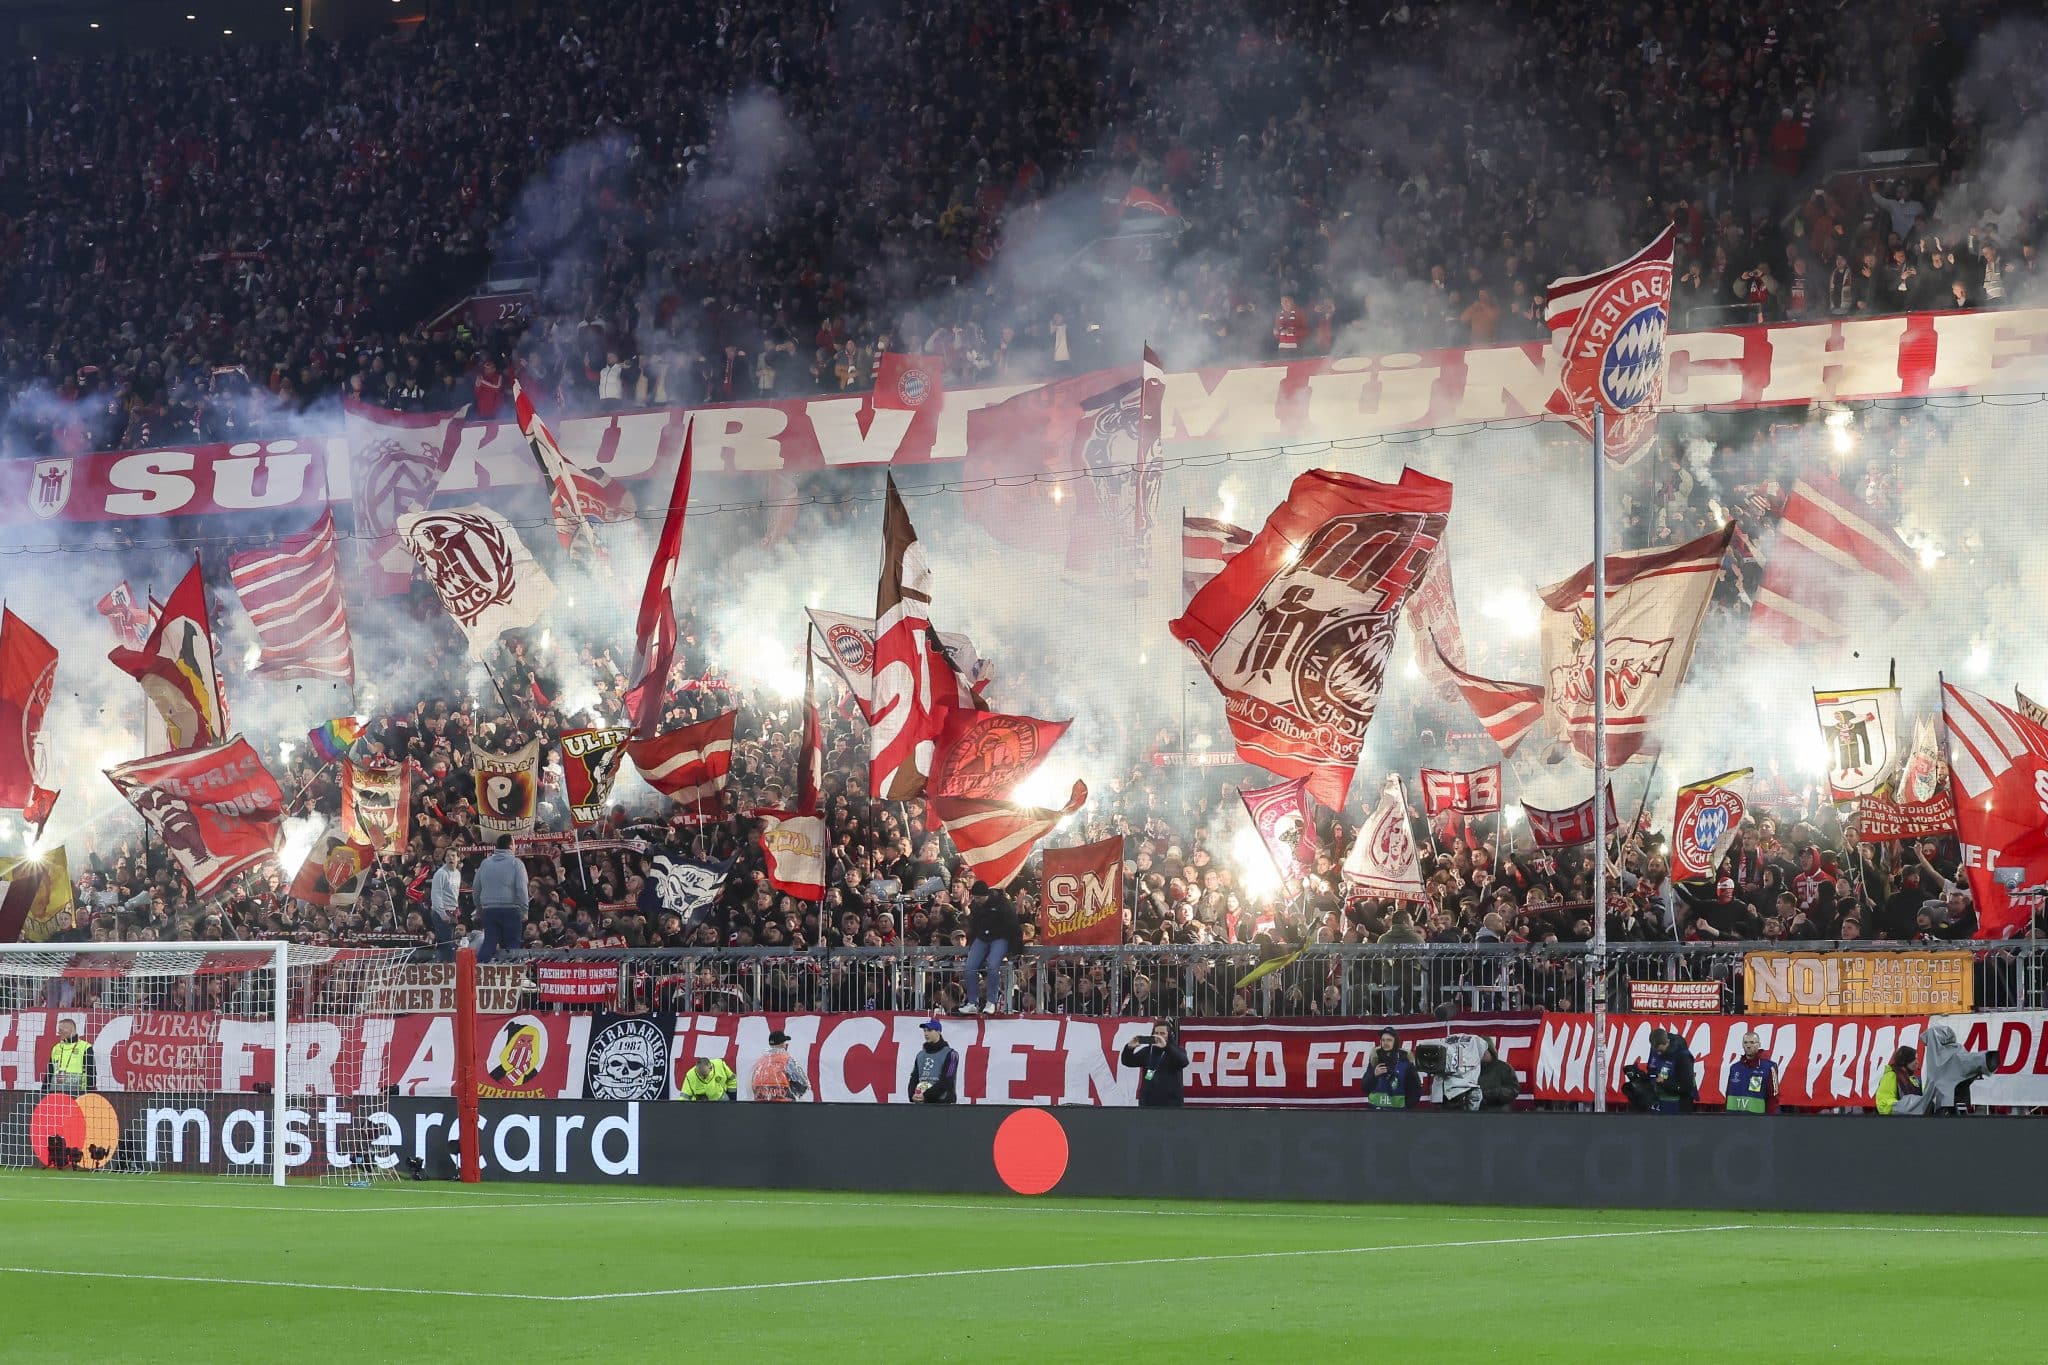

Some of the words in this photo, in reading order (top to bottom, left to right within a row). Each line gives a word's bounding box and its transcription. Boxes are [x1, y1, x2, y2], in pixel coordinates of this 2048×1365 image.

[1861, 820, 1901, 835] FUCK
[1047, 861, 1120, 921] SM
[1843, 958, 1866, 973] TO
[1874, 957, 1962, 973] MATCHES
[1632, 983, 1669, 994] NIEMALS
[1751, 956, 1841, 1007] NO!
[1872, 974, 1933, 989] BEHIND
[478, 988, 518, 1010] UNS
[1633, 999, 1666, 1009] IMMER
[1842, 989, 1903, 1004] CLOSED
[1910, 989, 1961, 1004] DOORS
[132, 1012, 210, 1037] ULTRAS
[618, 1041, 643, 1051] 1987
[126, 1041, 208, 1068] GEGEN
[1183, 1041, 1287, 1087] RED
[126, 1071, 207, 1092] RASSISMUS
[1736, 1097, 1749, 1109] TV
